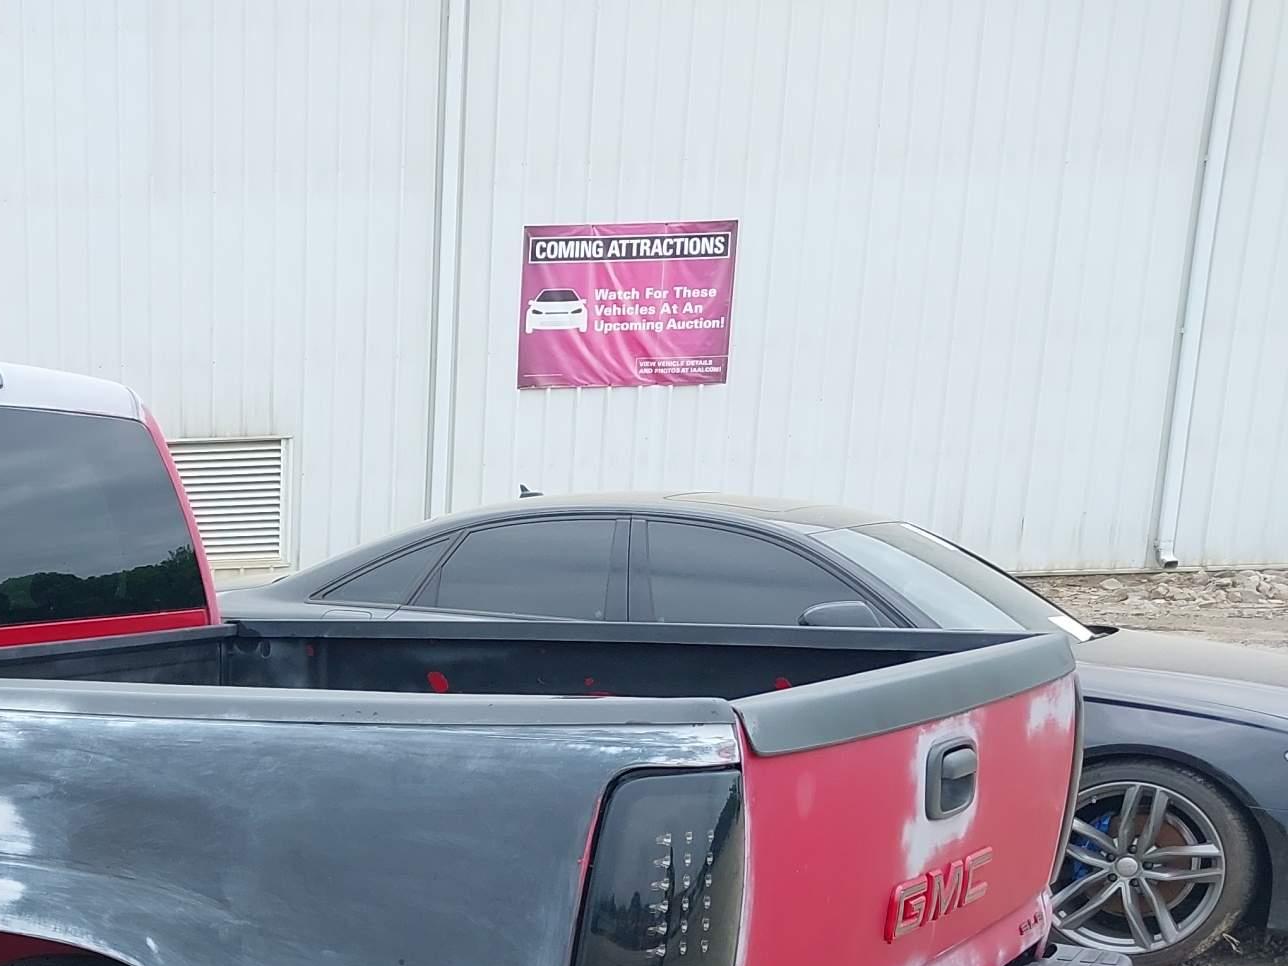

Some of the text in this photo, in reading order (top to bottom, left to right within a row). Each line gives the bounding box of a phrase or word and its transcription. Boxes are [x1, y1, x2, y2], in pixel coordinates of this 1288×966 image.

[535, 236, 725, 259] COMING ATTRACTIONS
[594, 287, 717, 300] Watch For These
[594, 303, 702, 316] Vehicles At An
[594, 317, 725, 333] Upcoming Auction!
[883, 846, 993, 944] GMC
